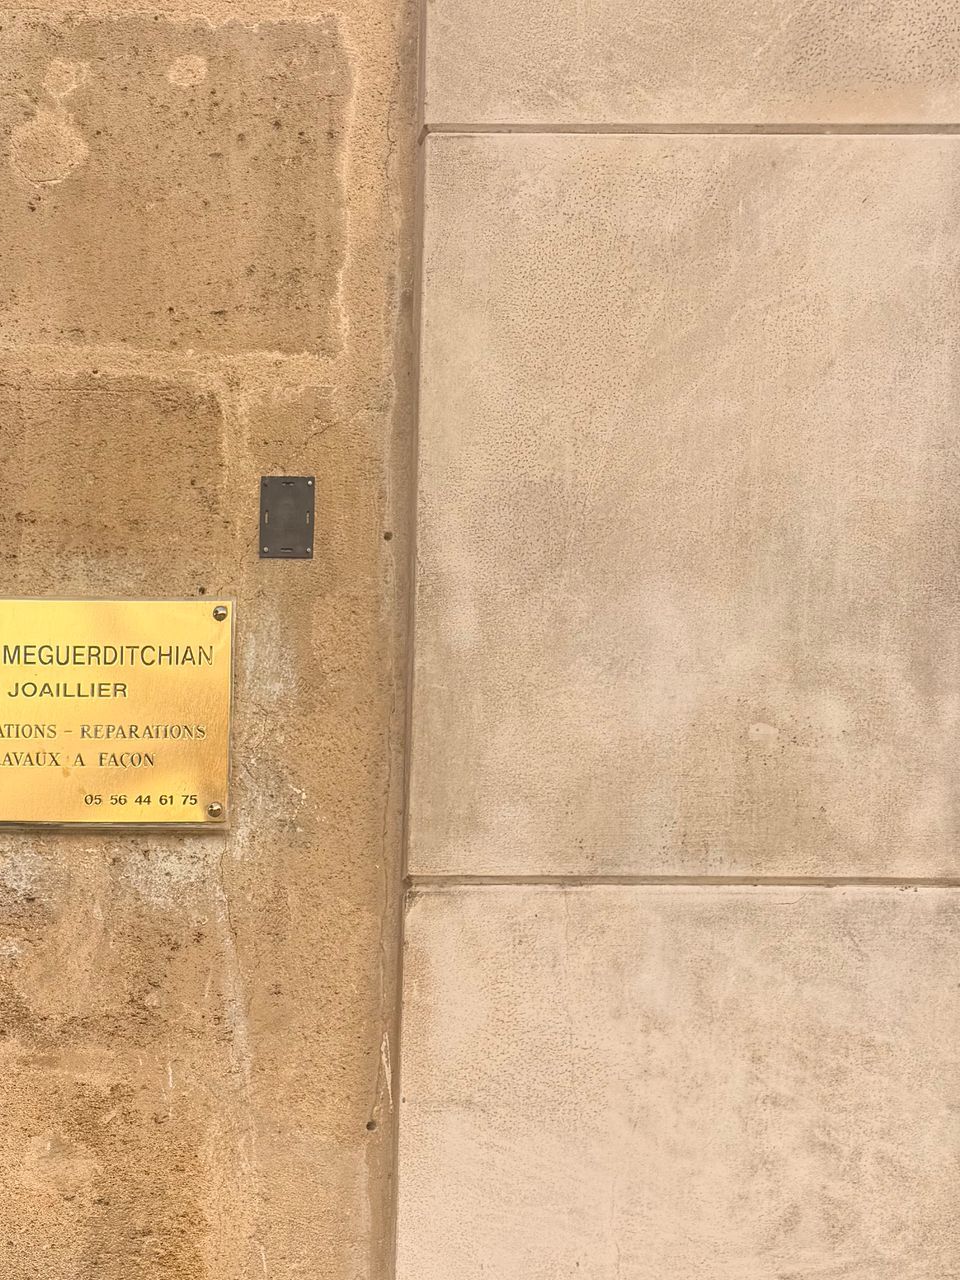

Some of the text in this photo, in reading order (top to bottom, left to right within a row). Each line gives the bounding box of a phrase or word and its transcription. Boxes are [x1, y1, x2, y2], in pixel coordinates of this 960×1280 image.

[2, 645, 213, 665] MEGUERDITCHIAN
[8, 683, 128, 698] JOAILLIER
[80, 724, 206, 739] REPARATIONS
[72, 753, 85, 767] A
[99, 753, 155, 769] FAÇON
[84, 795, 197, 806] 05 56 44 61 75
